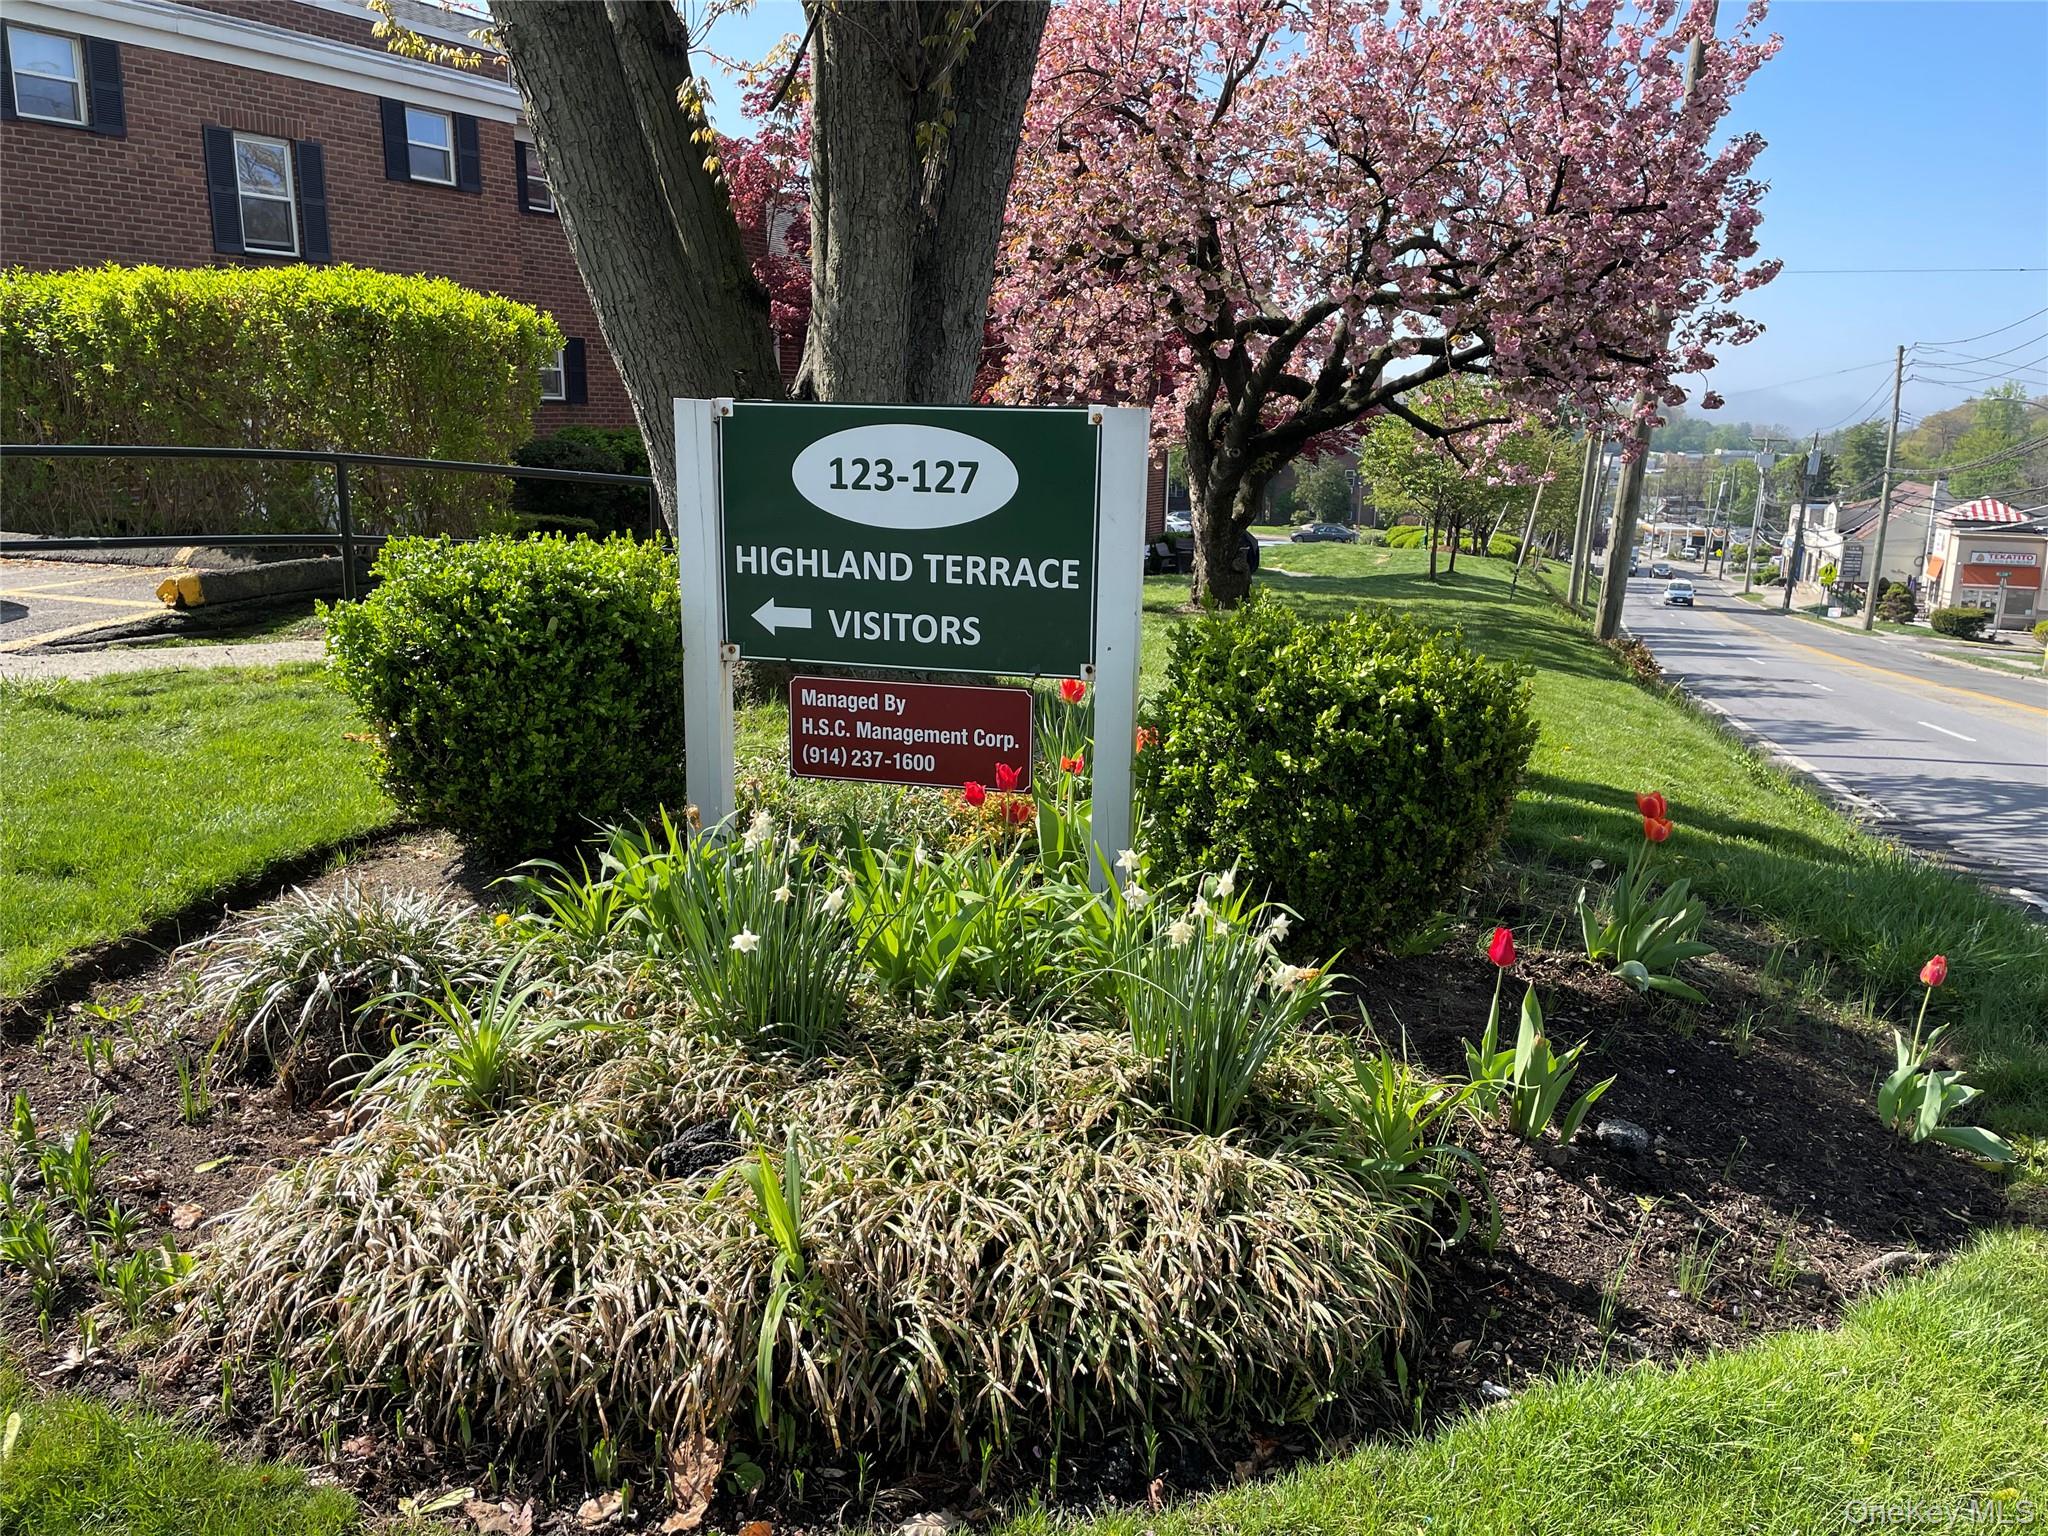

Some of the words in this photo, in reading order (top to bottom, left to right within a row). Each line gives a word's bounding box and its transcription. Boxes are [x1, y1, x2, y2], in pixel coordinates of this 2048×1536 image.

[829, 457, 980, 494] 123-127
[736, 545, 913, 582] HIGHLAND
[923, 553, 1080, 589] TERRACE
[1989, 553, 2034, 561] TEKATITO
[828, 609, 981, 646] VISITORS
[801, 688, 879, 713] Managed
[884, 693, 906, 715] By
[801, 717, 850, 738] H.S.C.
[856, 721, 968, 746] Management
[973, 728, 1020, 752] Corp.
[802, 743, 848, 768] (914)
[851, 749, 936, 773] 237-1600
